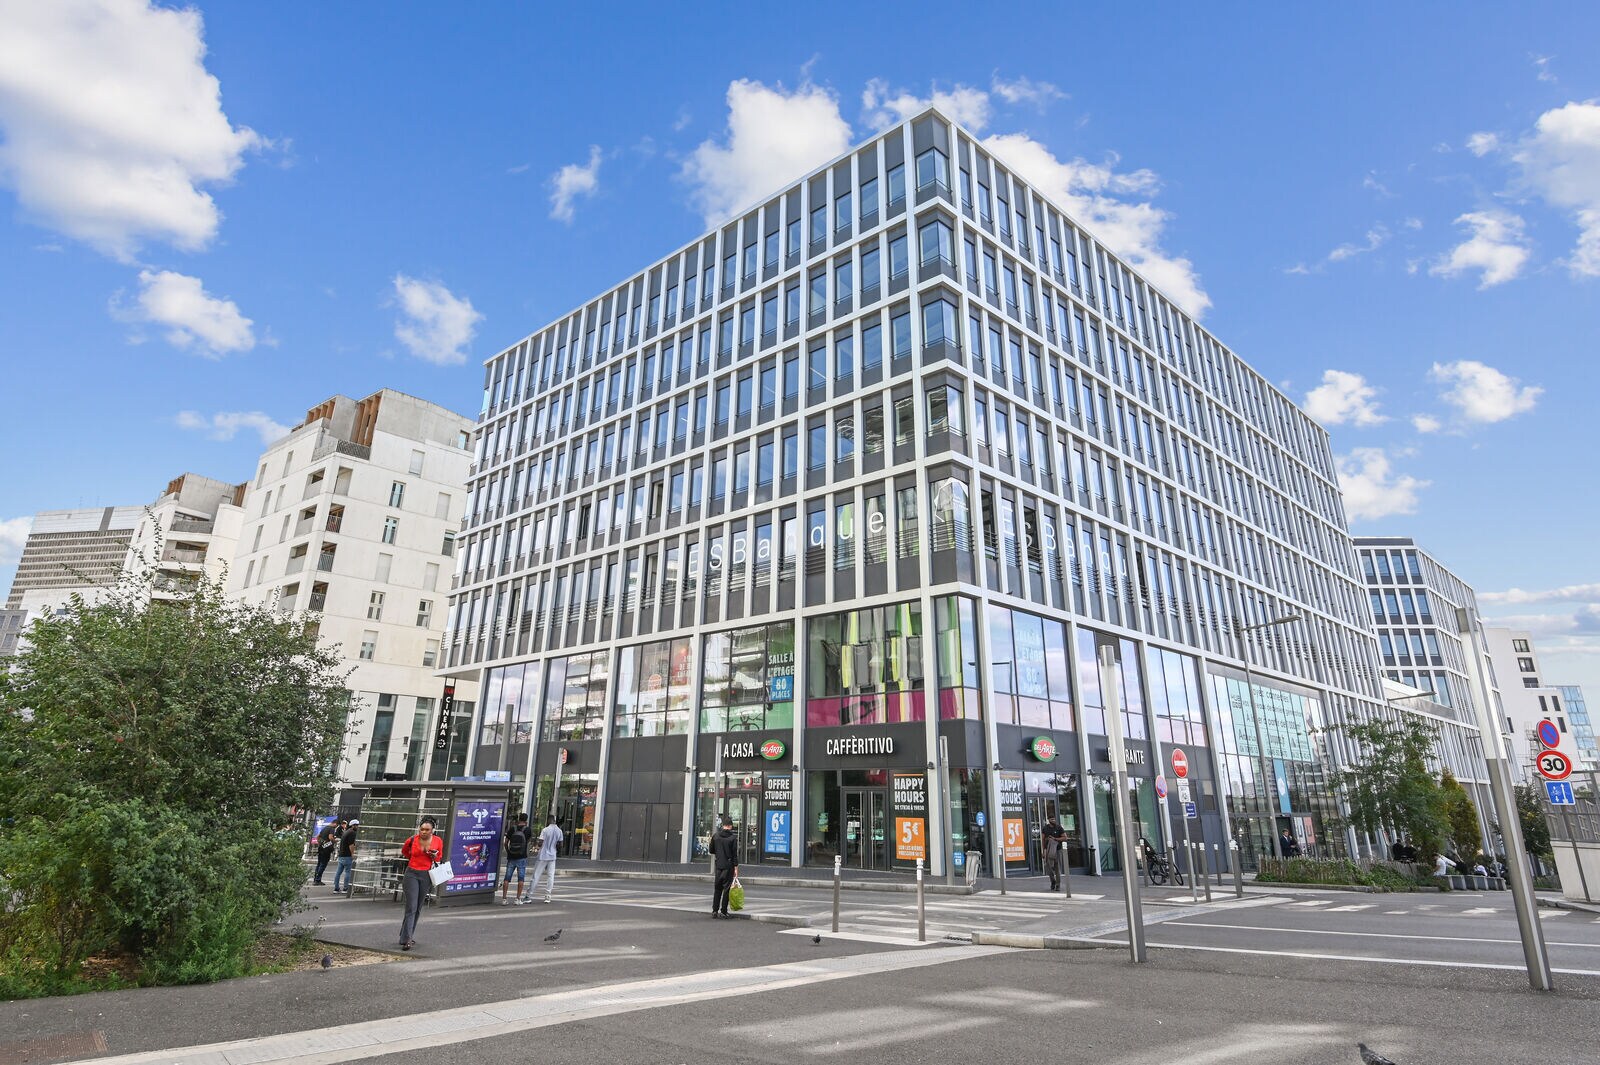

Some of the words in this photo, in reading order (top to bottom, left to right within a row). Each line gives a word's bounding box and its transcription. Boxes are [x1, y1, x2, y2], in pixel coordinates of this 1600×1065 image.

[689, 511, 884, 574] ESBanque
[768, 653, 788, 664] SALLE
[768, 665, 794, 678] L'ÉTAGE
[776, 678, 786, 690] 80
[731, 743, 754, 757] CASA
[826, 735, 894, 755] CAFFÈRITIVO
[1542, 758, 1565, 772] 30
[768, 779, 790, 790] OFFRE
[894, 778, 924, 790] HAPPY
[1000, 780, 1020, 791] HAPPY
[902, 822, 919, 843] 5€
